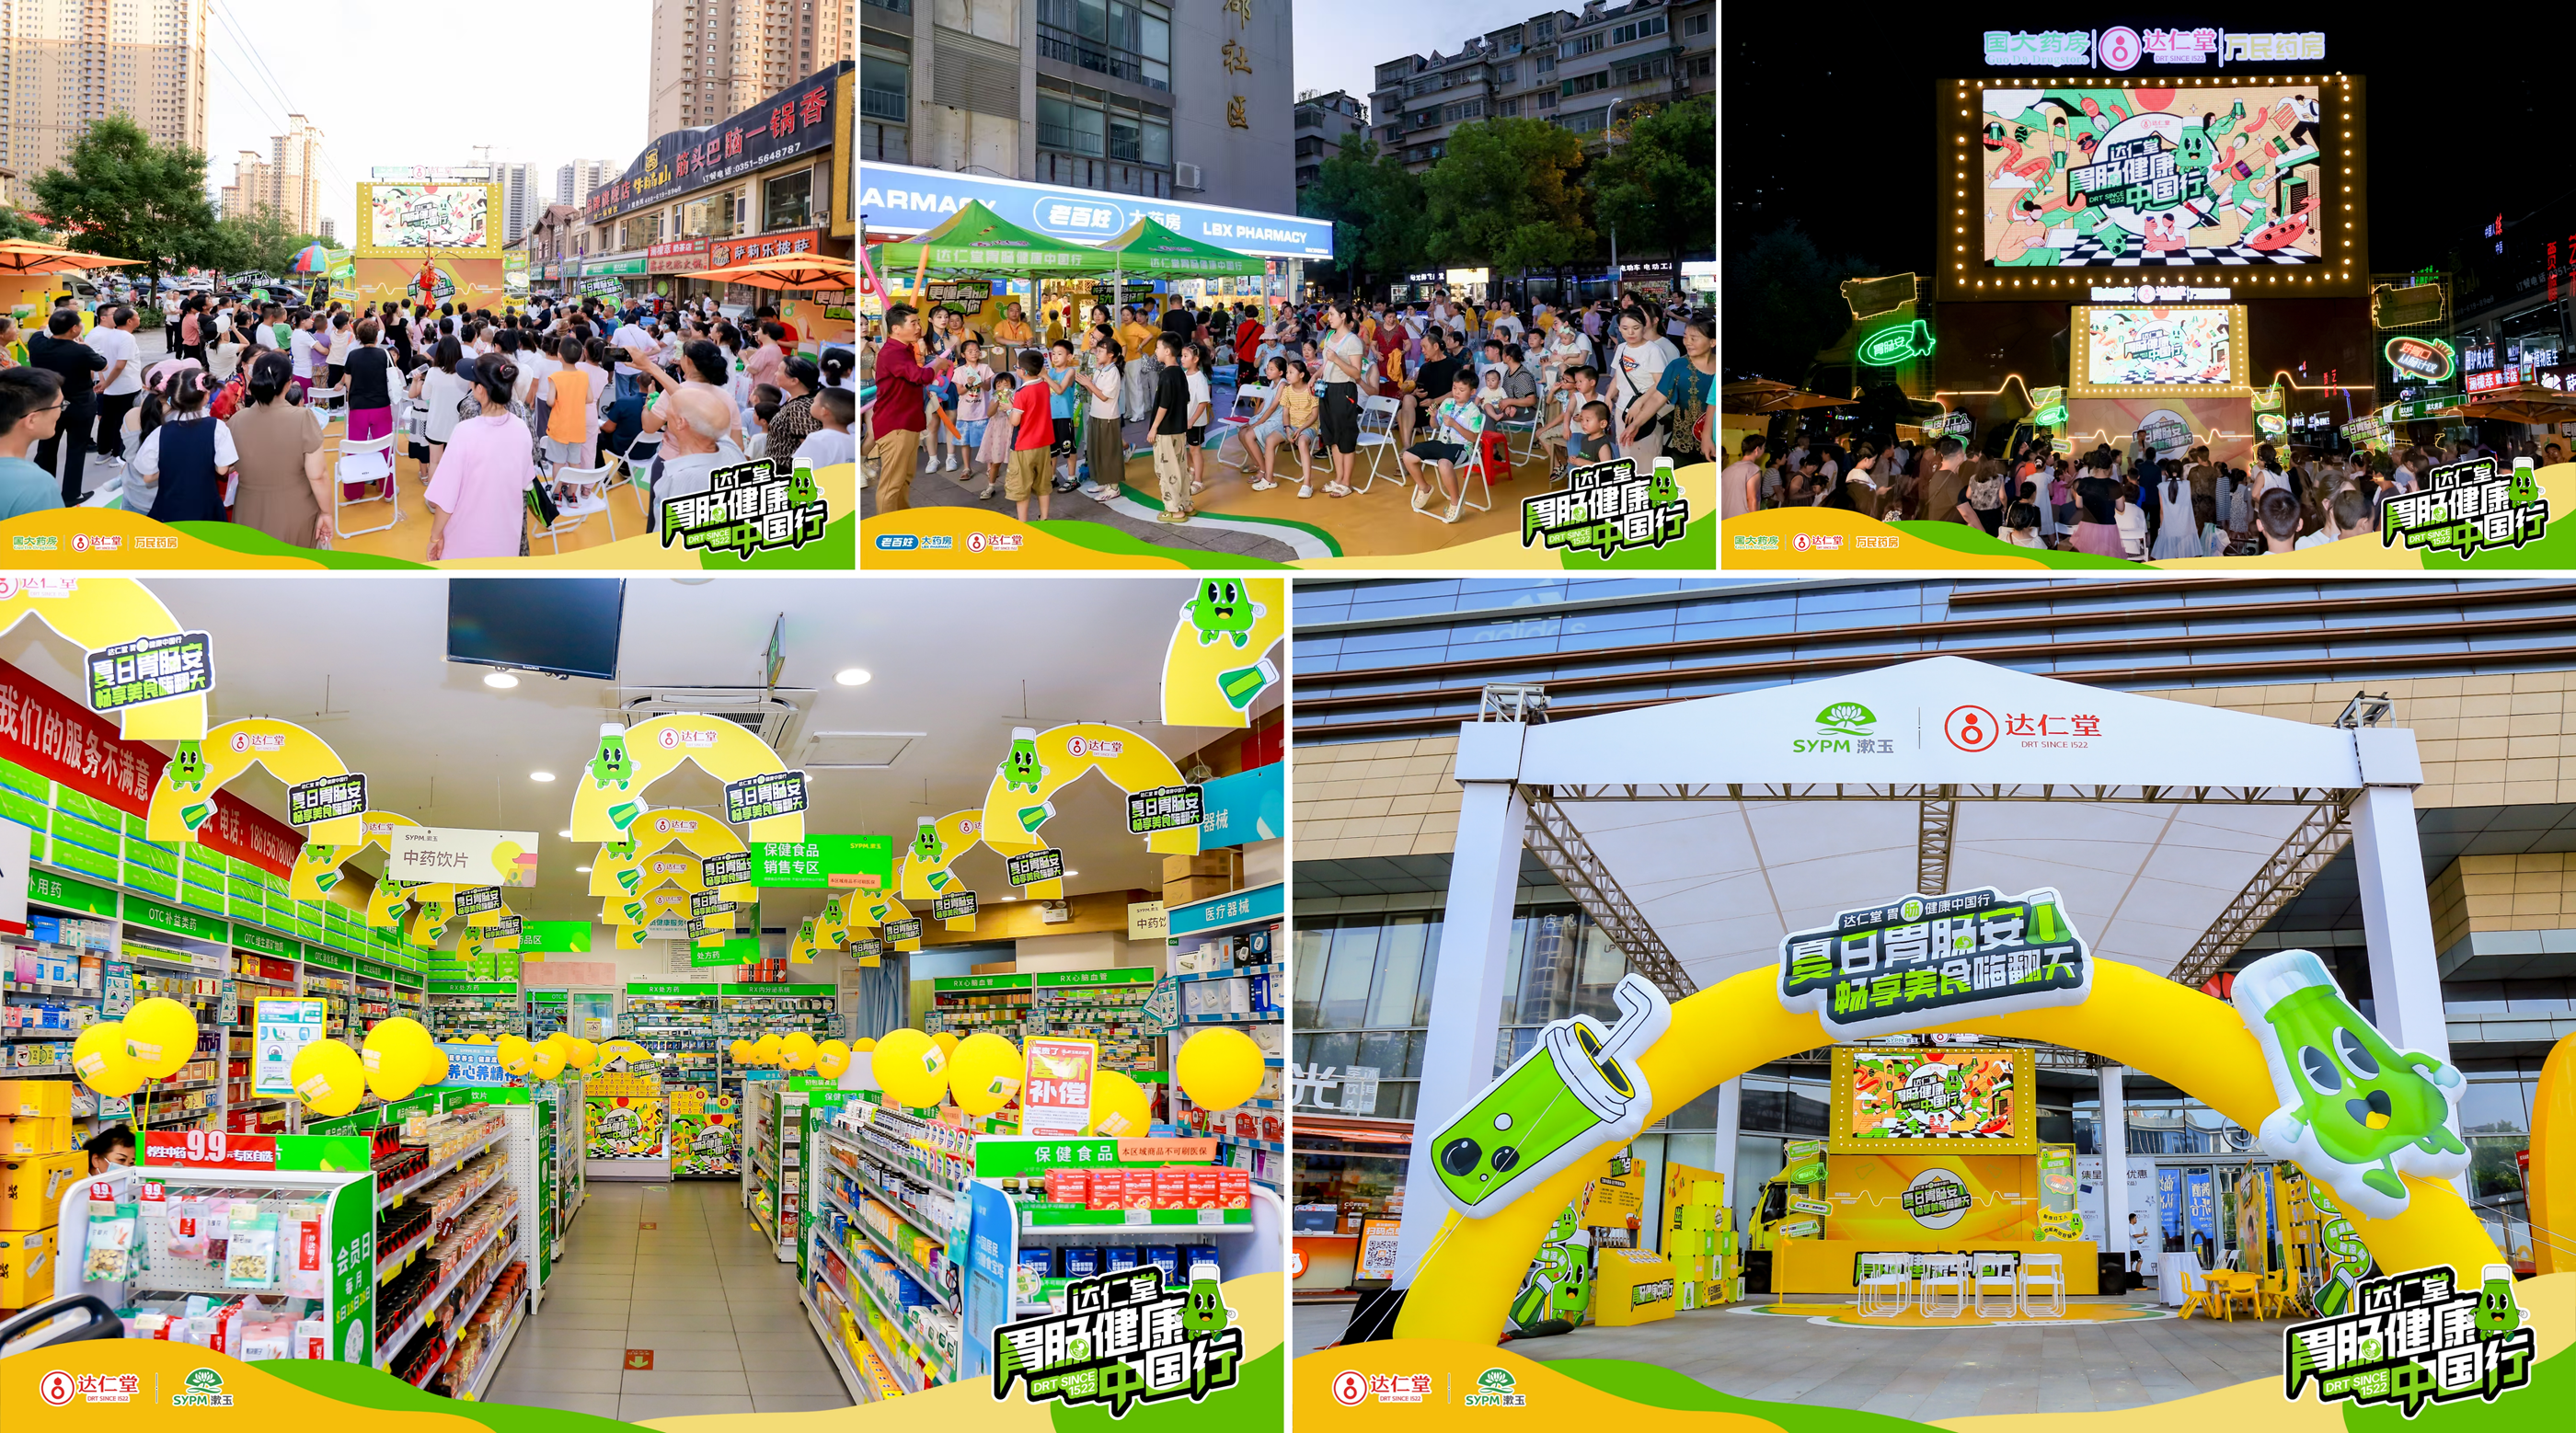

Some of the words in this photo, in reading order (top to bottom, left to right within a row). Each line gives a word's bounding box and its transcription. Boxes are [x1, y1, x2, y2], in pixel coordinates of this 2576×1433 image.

[1984, 30, 2089, 52] 国大药房
[2144, 29, 2215, 52] 达仁堂
[2225, 33, 2325, 60] 万民药房
[1986, 55, 2009, 63] Guo
[2013, 55, 2029, 63] Da
[2032, 55, 2088, 65] Drugstore
[675, 85, 827, 178] 筋头巴脑一锅香
[2110, 139, 2159, 162] 达仁堂
[2072, 153, 2175, 195] 胃肠健康
[2088, 195, 2103, 203] DRT
[2105, 190, 2124, 200] SINCE
[2126, 173, 2204, 212] 中国行
[1048, 203, 1111, 229] 老百姓
[1203, 222, 1233, 237] LBX
[1236, 226, 1307, 244] PHARMACY
[937, 249, 1082, 266] 达仁堂胃肠健康中国行
[1150, 258, 1242, 271] 达仁堂胃肠健康中国行
[1873, 337, 1905, 357] 胃肠安
[2399, 342, 2432, 360] 好胃口
[2495, 371, 2518, 385] 奶茶店
[93, 643, 203, 688] 夏日胃肠安
[95, 670, 206, 708] 畅享美食嗨翻天
[681, 730, 719, 742] 达仁堂
[2005, 714, 2102, 737] 达仁堂
[0, 683, 150, 802] 我们的服务不满意
[252, 734, 284, 746] 达仁堂
[1088, 741, 1122, 752] 达仁堂
[1792, 739, 1850, 753] SYPM
[1857, 739, 1893, 753] 漱玉
[293, 781, 362, 810] 夏日胃肠安
[730, 778, 800, 808] 夏日胃肠安
[293, 801, 362, 824] 畅享美食嗨翻天
[731, 797, 803, 823] 畅享美食嗨翻天
[1132, 792, 1198, 819] 夏日胃肠安
[672, 820, 697, 829] 达仁堂
[1133, 810, 1200, 831] 畅享美食嗨翻天
[1203, 810, 1228, 833] 器械
[403, 849, 468, 868] 中药饮片
[765, 843, 819, 857] 保健食品
[665, 863, 687, 871] 达仁堂
[765, 861, 819, 874] 销售专区
[1010, 856, 1059, 876] 夏日胃肠安
[456, 889, 498, 907] 夏日胃肠安
[936, 895, 974, 911] 夏日胃肠安
[149, 908, 164, 923] OTC
[166, 912, 197, 931] 补益类药
[1205, 899, 1249, 922] 医疗器械
[1843, 910, 1882, 927] 达仁堂
[1887, 893, 1990, 922] 胃肠健康中国行
[245, 933, 255, 945] OTC
[1792, 906, 2024, 987] 夏日胃肠安
[697, 951, 720, 959] 处方药
[1060, 973, 1108, 981] RX心脑血管
[1834, 946, 2075, 1015] 畅享美食嗨翻天
[1031, 1057, 1088, 1081] 差价
[1029, 1080, 1087, 1105] 补偿
[1293, 1062, 1338, 1110] 光
[1914, 1075, 1937, 1087] 达仁堂
[1894, 1083, 1945, 1107] 胃肠健康
[1921, 1093, 1960, 1113] 中国行
[1035, 1146, 1112, 1163] 保健食品
[1121, 1147, 1207, 1156] 本区域商品不可刷医保
[2126, 1170, 2148, 1179] 优惠
[1903, 1185, 1958, 1209] 夏日胃肠安
[337, 1232, 371, 1277] 会员日
[345, 1270, 362, 1296] 每月
[335, 1287, 371, 1325] 8日18日28日
[1631, 1278, 1673, 1313] 胃肠健康中国行
